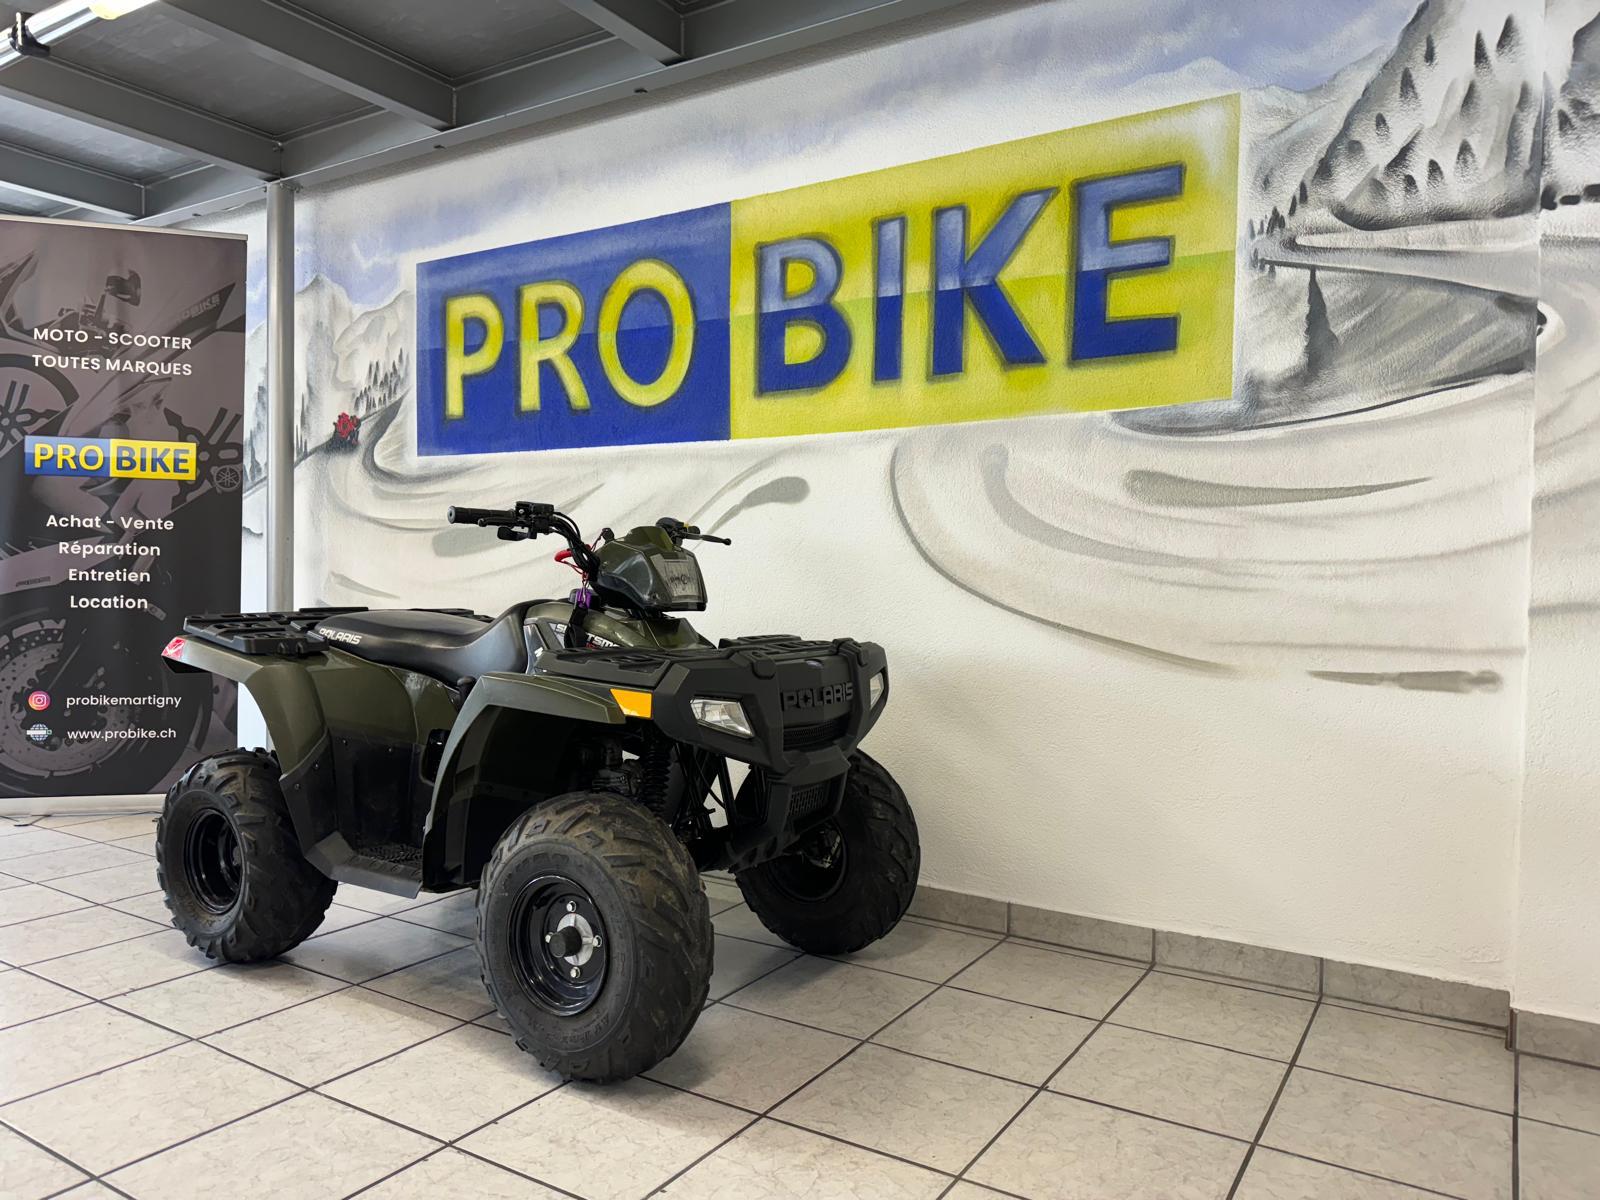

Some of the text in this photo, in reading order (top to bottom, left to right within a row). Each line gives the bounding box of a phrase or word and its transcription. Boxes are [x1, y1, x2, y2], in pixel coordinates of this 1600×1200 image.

[444, 162, 1186, 420] PRO BIKE
[33, 327, 89, 343] MOTO
[108, 331, 192, 350] SCOOTER
[31, 354, 193, 376] TOUTES MARQUES
[33, 443, 191, 474] PRO BIKE
[46, 514, 102, 529] Achat
[120, 516, 175, 530] Vente
[58, 540, 161, 558] Réparation
[68, 568, 151, 583] Entretien
[70, 594, 149, 609] Location
[319, 628, 362, 645] POLARIS
[66, 694, 182, 709] probikemartigny
[780, 682, 853, 710] POLARIS
[67, 727, 177, 742] www.probike.ch
